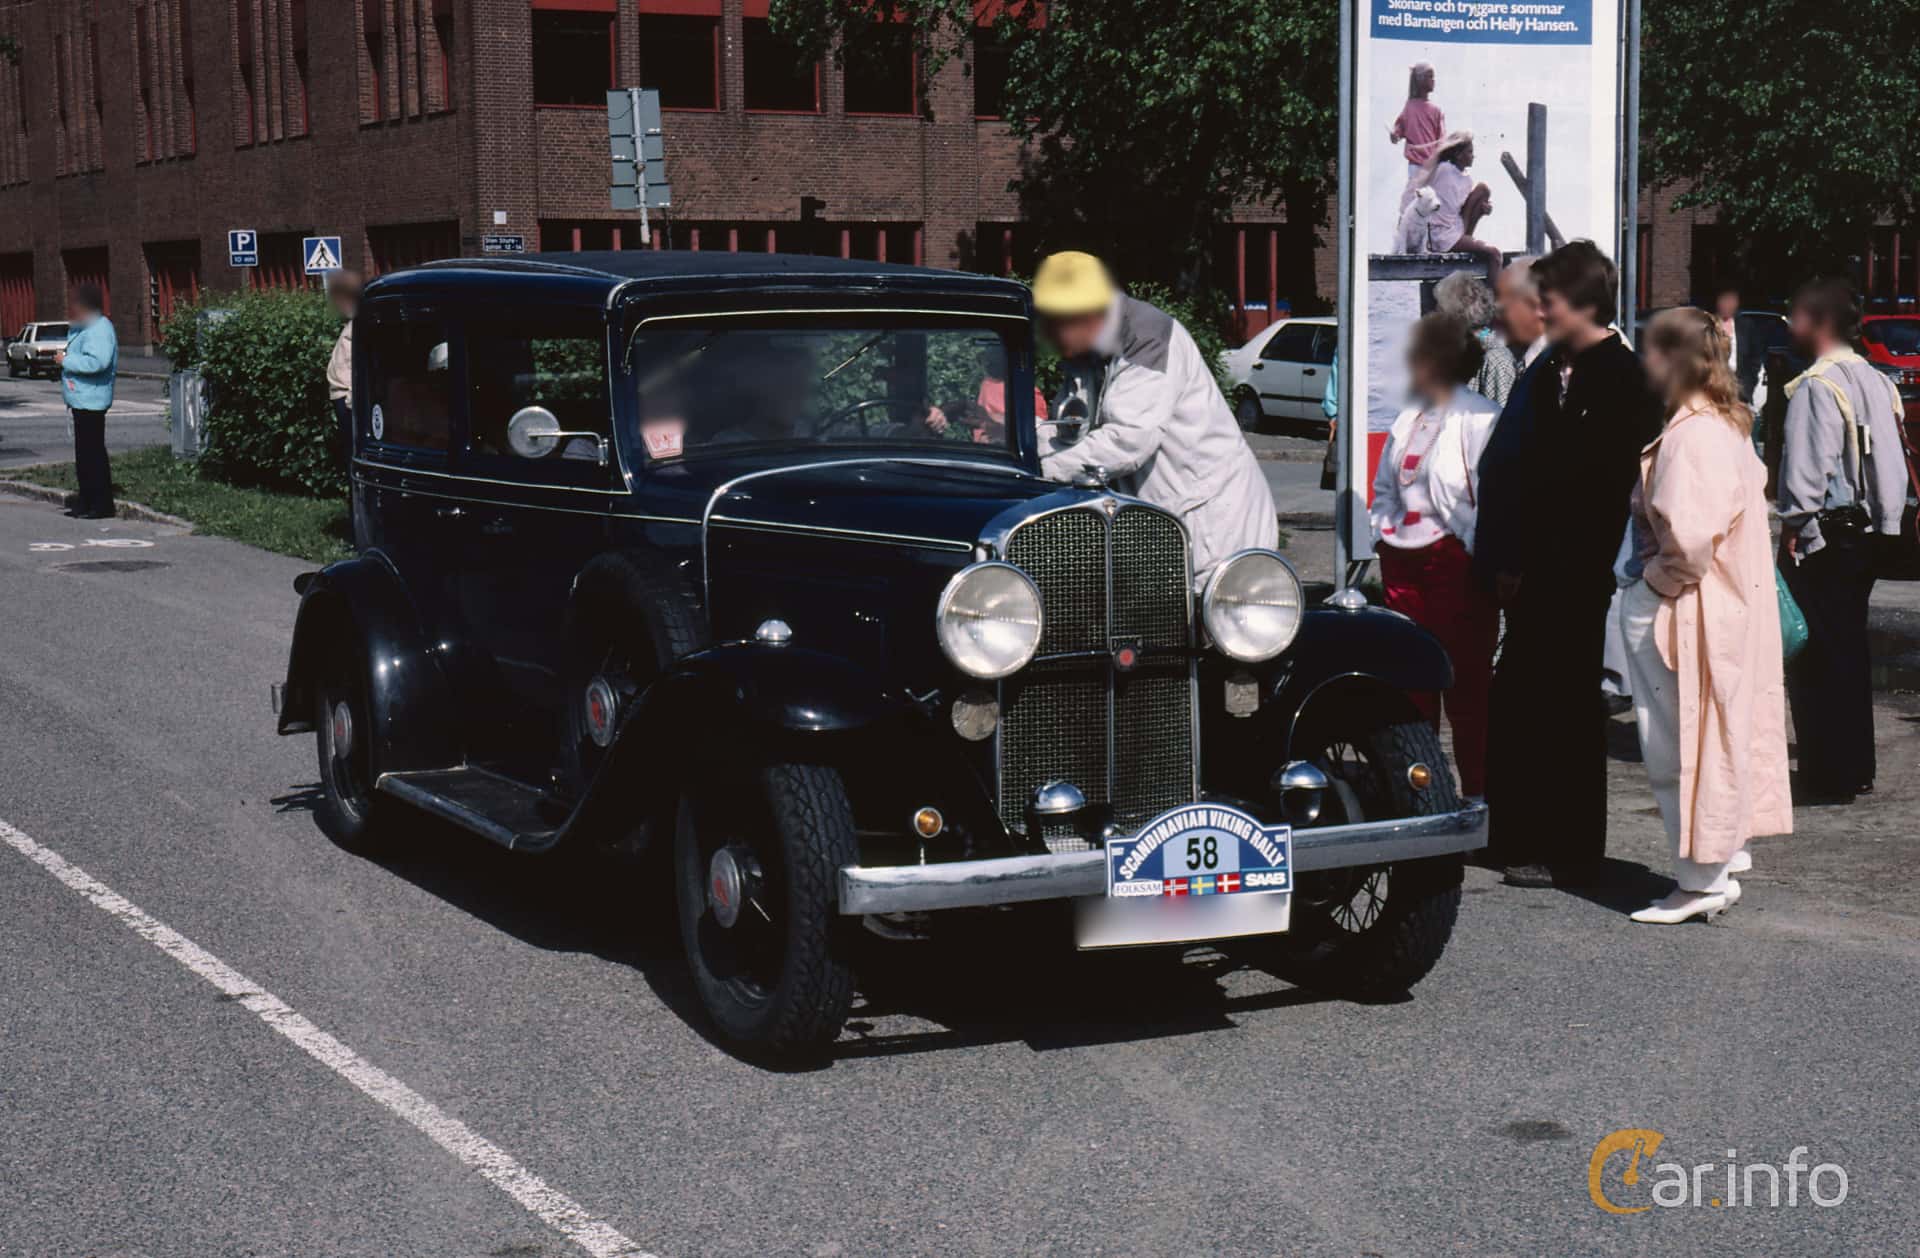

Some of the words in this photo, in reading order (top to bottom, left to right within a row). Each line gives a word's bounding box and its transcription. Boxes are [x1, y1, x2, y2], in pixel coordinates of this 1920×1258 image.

[1434, 0, 1455, 12] och
[1457, 2, 1508, 17] tryggare
[1510, 4, 1565, 15] sommar
[1378, 14, 1402, 26] med
[1404, 13, 1464, 33] Barnängen
[1466, 17, 1488, 30] och
[1490, 17, 1523, 35] Helly
[1525, 17, 1579, 32] Hansen.
[237, 233, 250, 250] P
[1119, 810, 1208, 880] SCANDINAVIAN
[1209, 810, 1251, 840] VIKING
[1249, 830, 1285, 868] RALLY
[1186, 836, 1219, 871] 58
[1245, 872, 1286, 887] SAAB
[1115, 882, 1162, 895] FOLKSAM
